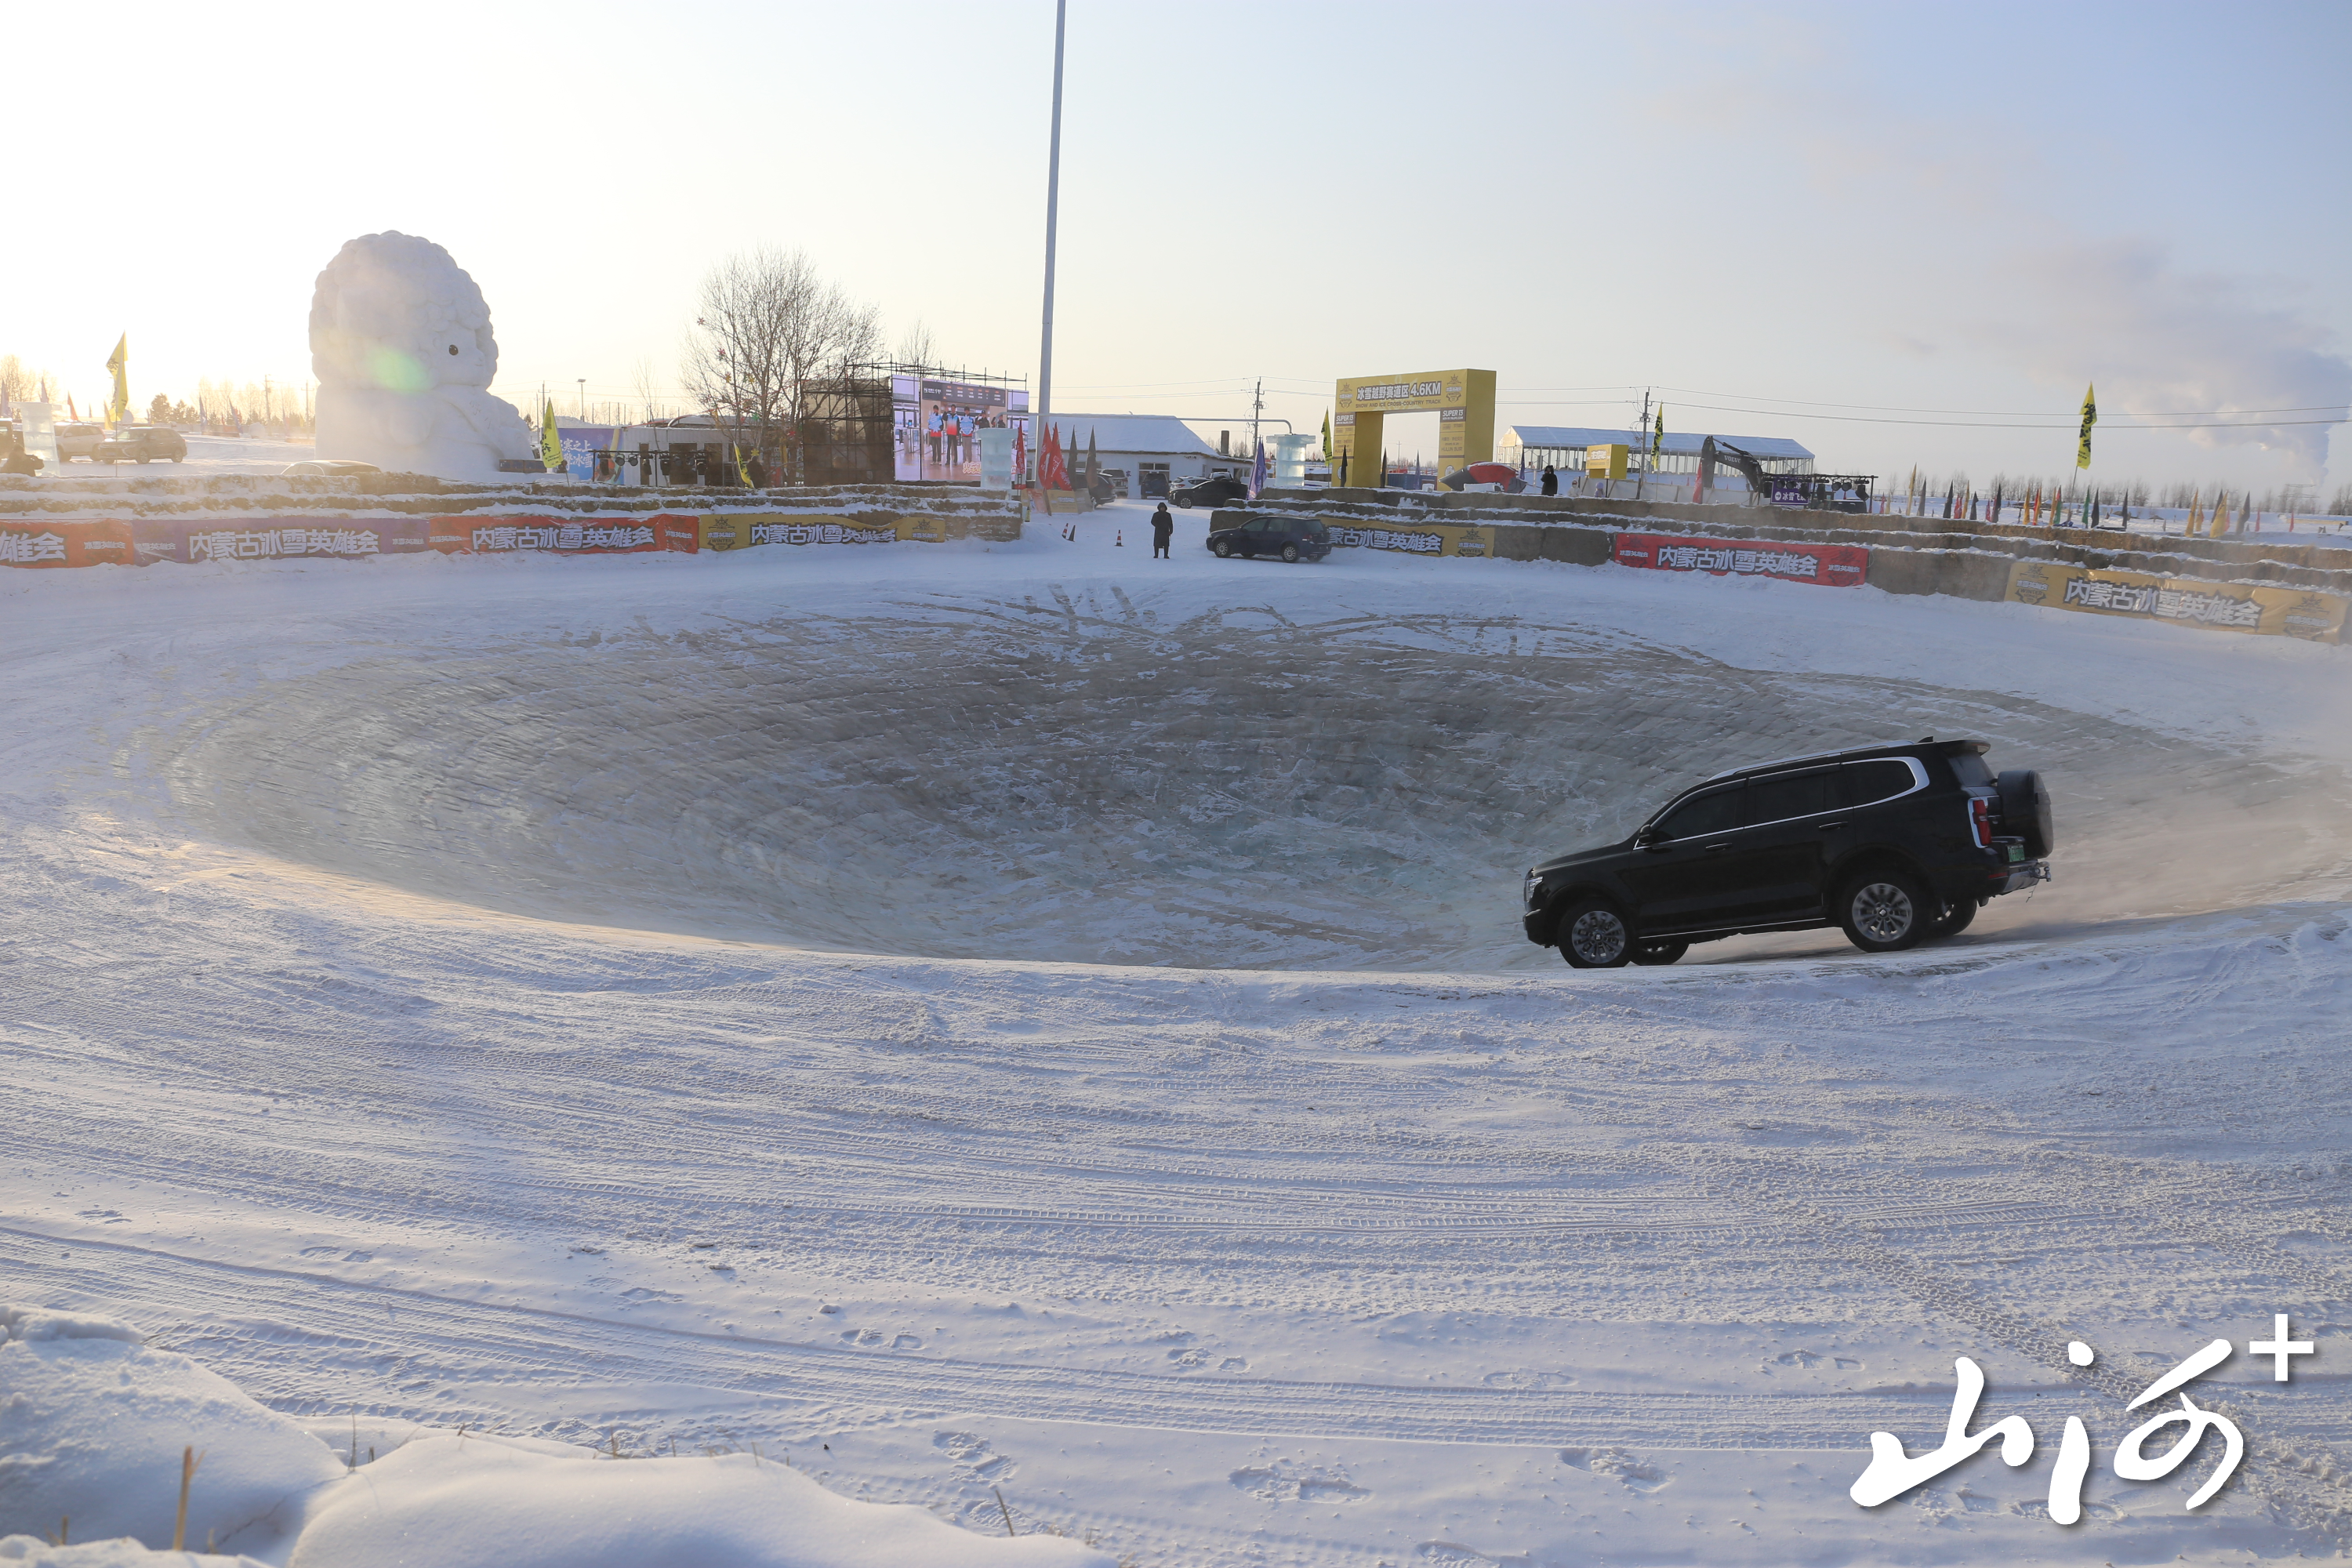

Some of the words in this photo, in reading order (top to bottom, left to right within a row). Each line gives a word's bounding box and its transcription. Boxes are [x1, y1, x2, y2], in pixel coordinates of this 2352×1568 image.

[1357, 385, 1410, 401] 冰雪越野赛道区
[1410, 382, 1441, 397] 4.6KM
[189, 528, 379, 559] 内蒙古冰雪英雄会
[472, 526, 655, 549] 内蒙古冰雪英雄会
[1657, 546, 1818, 577] 内蒙古冰雪英雄会
[2067, 579, 2261, 626] 内蒙古冰雪英雄会
